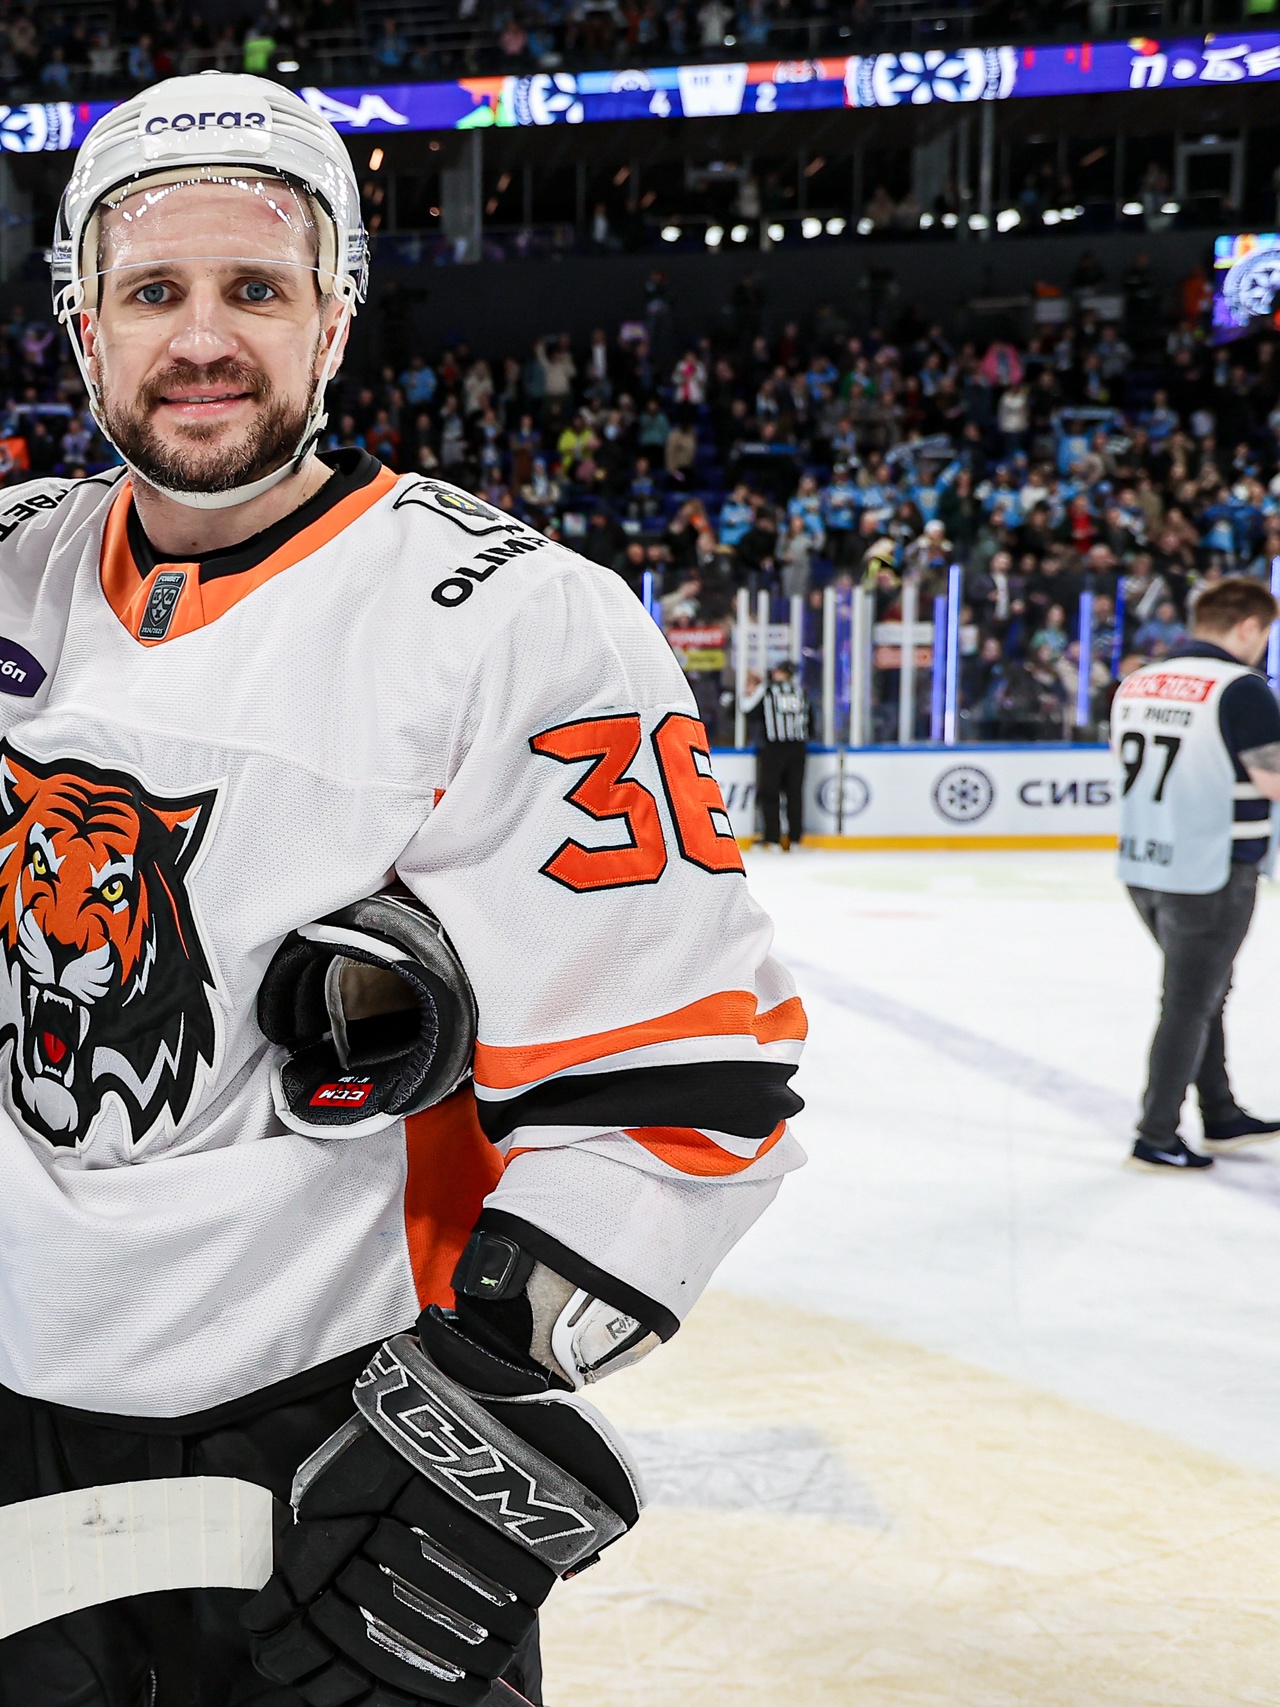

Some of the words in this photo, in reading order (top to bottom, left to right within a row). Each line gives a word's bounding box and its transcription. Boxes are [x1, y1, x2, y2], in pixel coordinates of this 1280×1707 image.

[649, 90, 671, 118] 4
[755, 82, 777, 113] 2
[145, 111, 266, 136] согаз
[528, 712, 747, 893] 36
[319, 1089, 365, 1101] CCM
